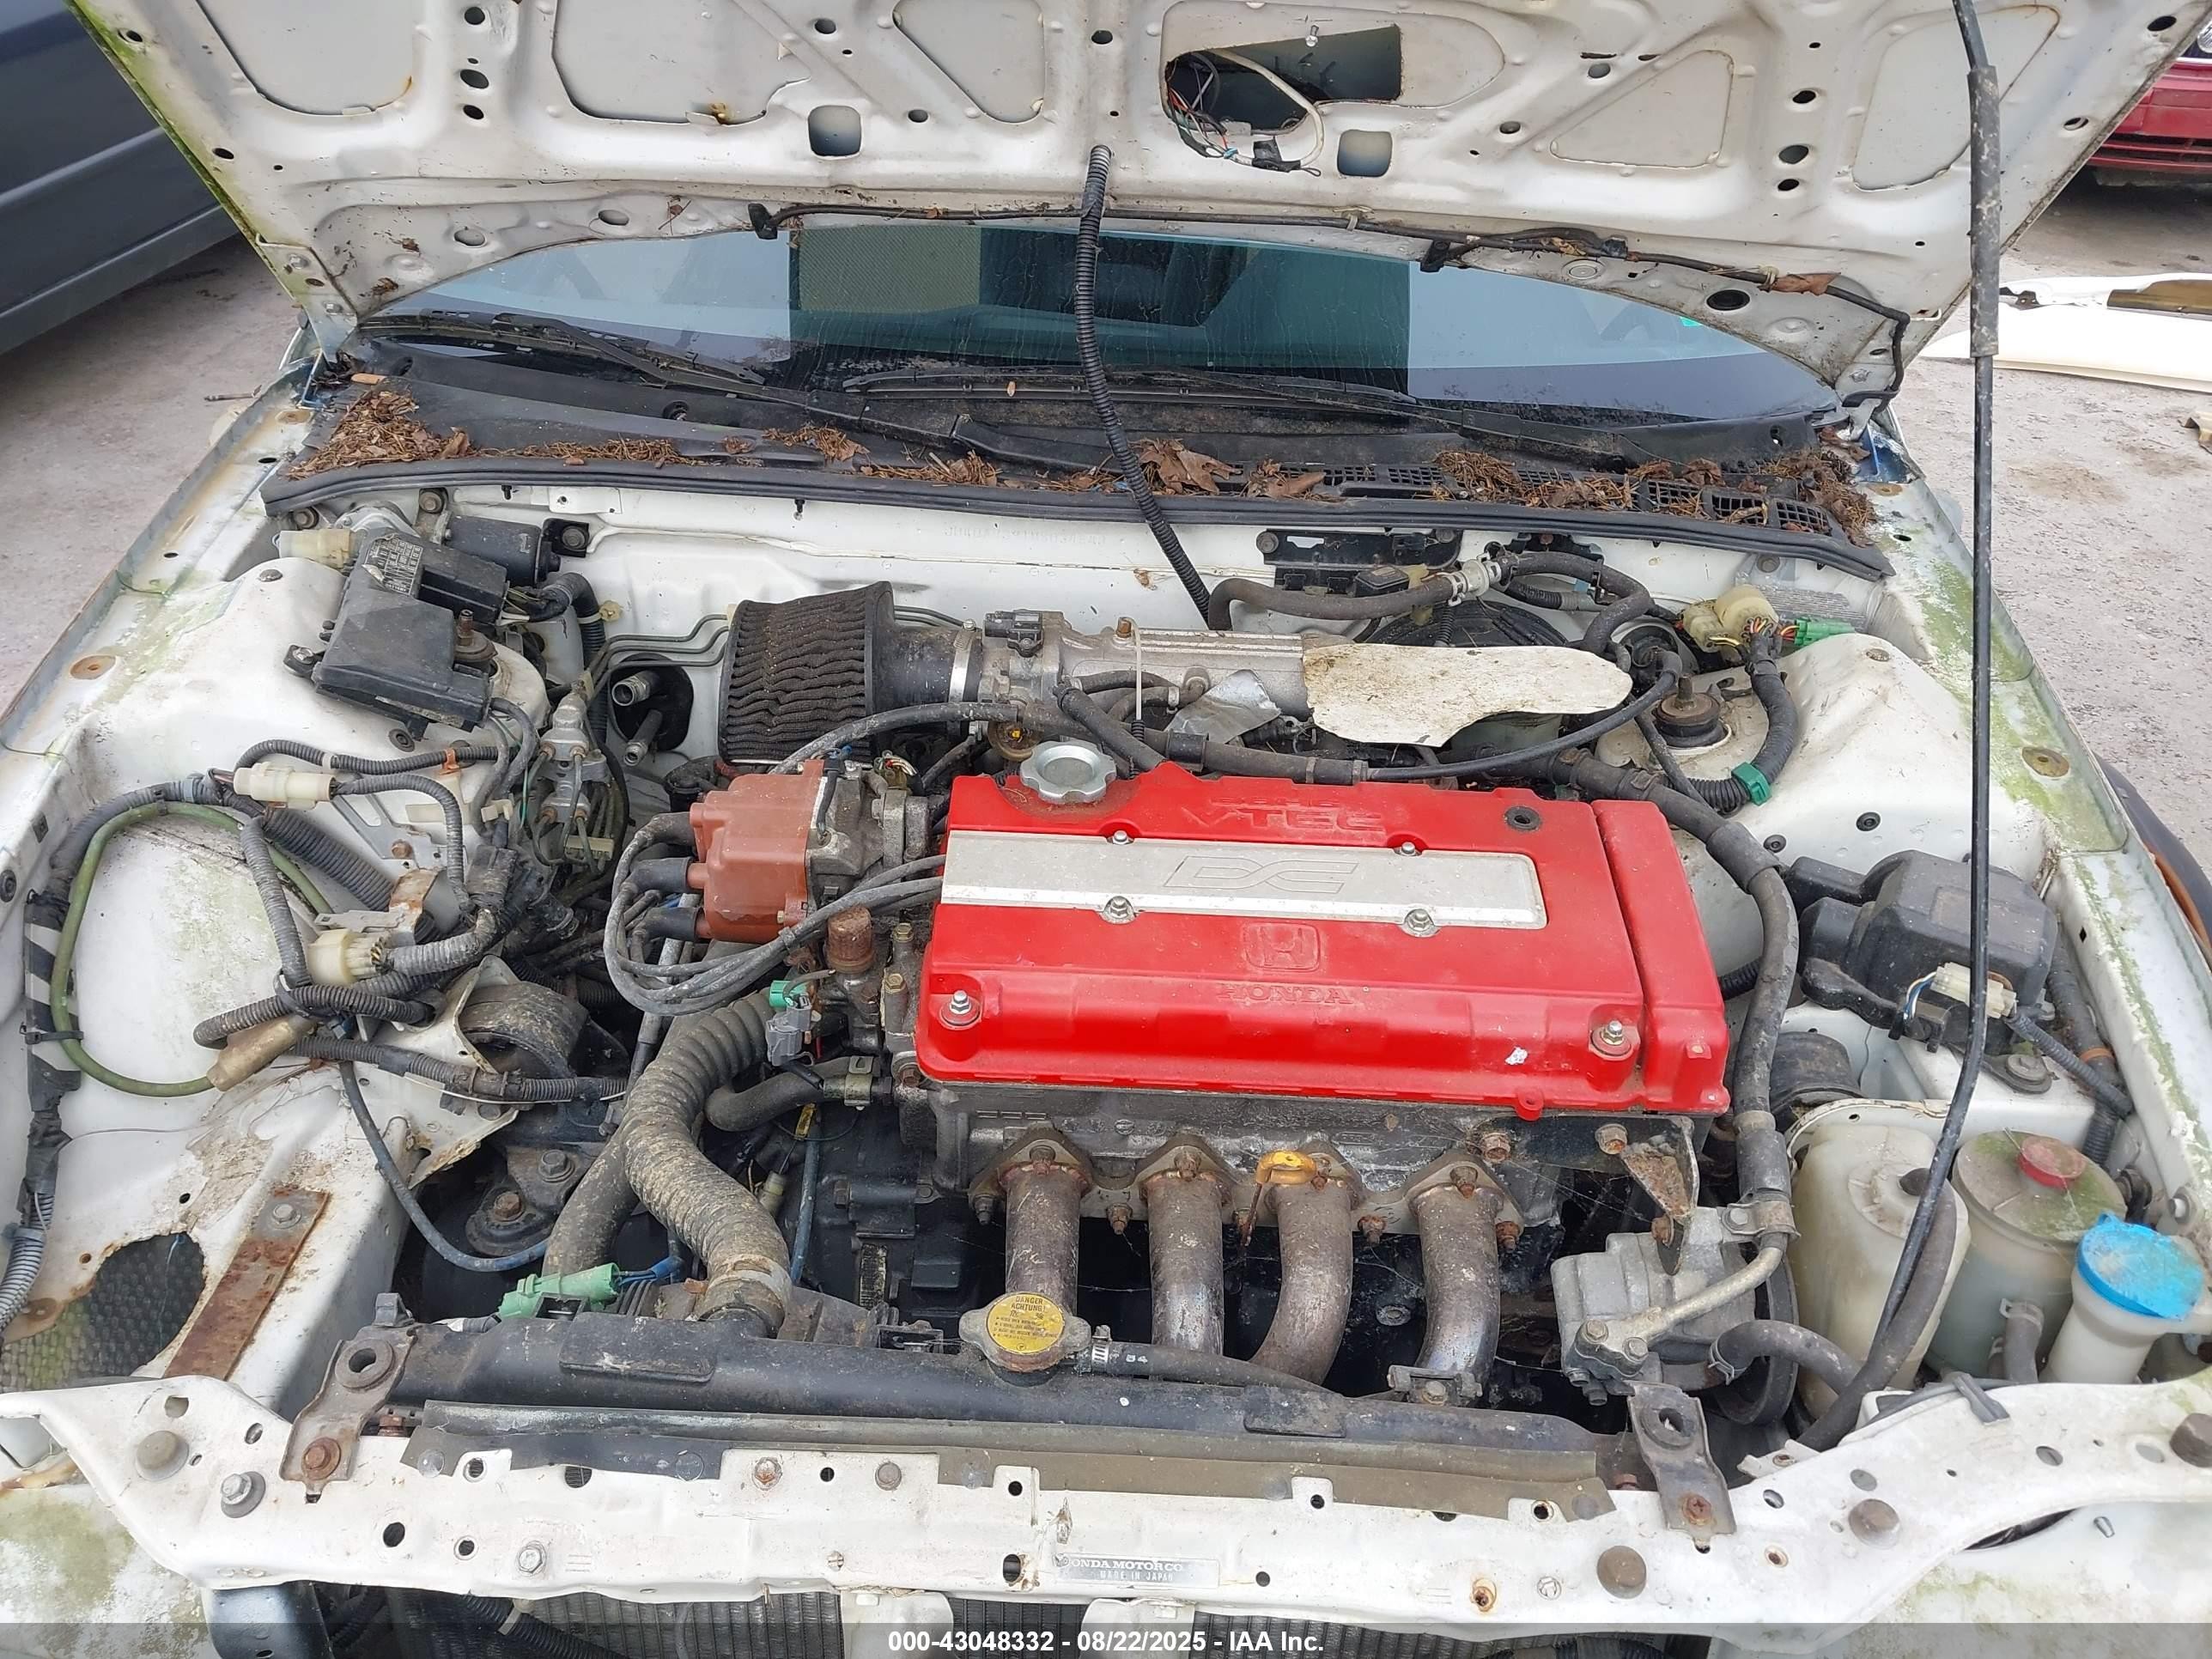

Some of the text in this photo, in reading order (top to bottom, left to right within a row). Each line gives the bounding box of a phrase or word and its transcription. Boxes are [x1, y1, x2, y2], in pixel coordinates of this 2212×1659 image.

[1181, 805, 1386, 834] VTEC
[1218, 982, 1354, 1005] HONDA
[1015, 1296, 1043, 1305] DANGER
[1011, 1303, 1046, 1312] ACHTUNG!
[1066, 1558, 1110, 1569] ONDA
[1099, 1570, 1174, 1582] MADE IN JAPAN
